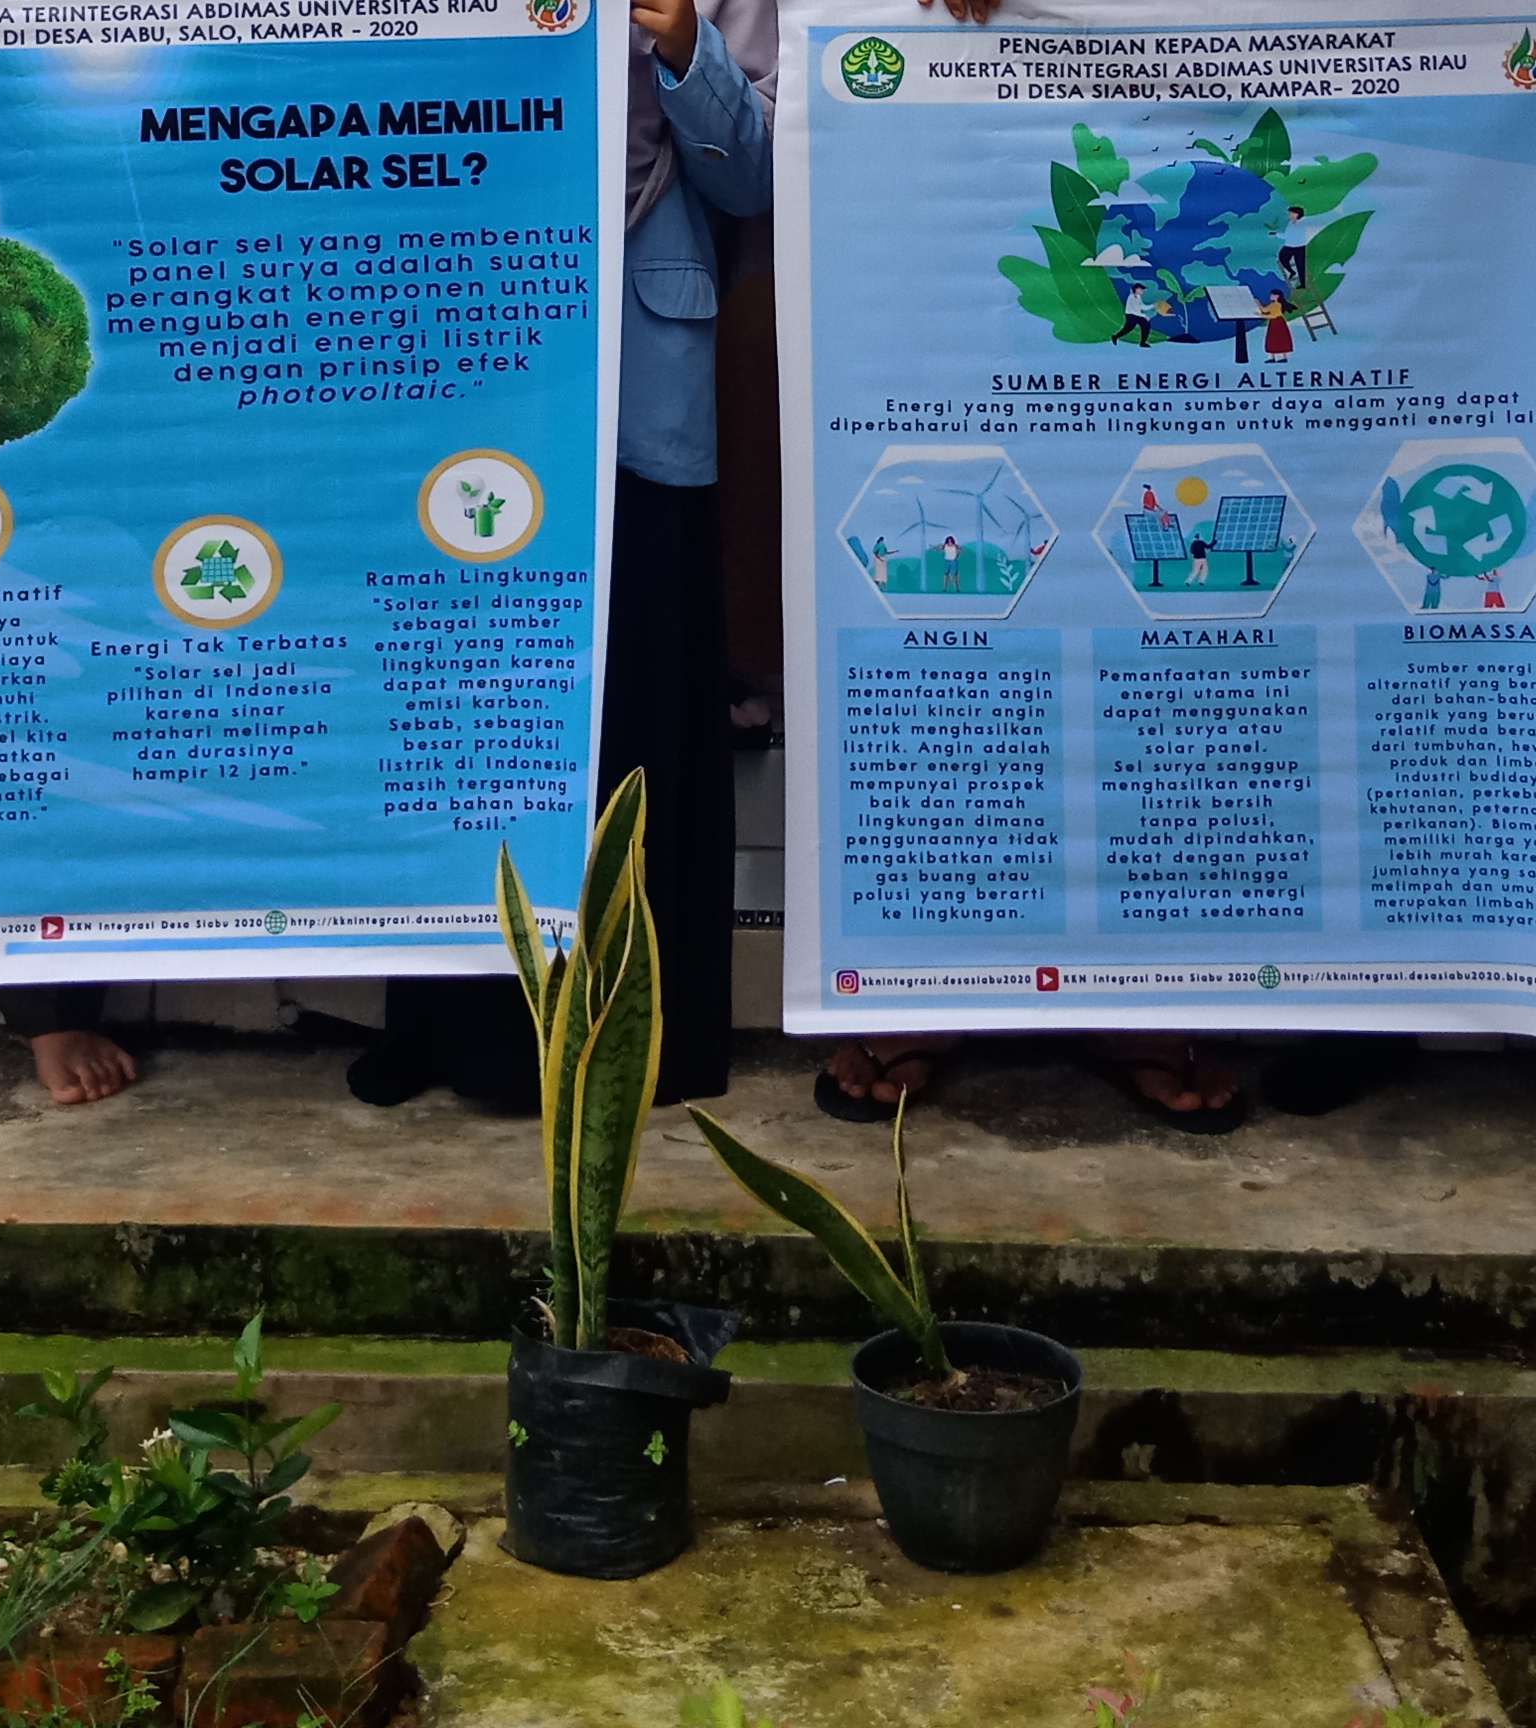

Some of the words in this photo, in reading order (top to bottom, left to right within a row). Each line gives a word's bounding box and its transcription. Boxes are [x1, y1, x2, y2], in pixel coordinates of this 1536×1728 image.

[22, 4, 177, 23] TERINTEGRASI
[186, 1, 291, 20] ABDIMAS
[3, 29, 25, 45] DI
[35, 28, 93, 45] DESA
[101, 26, 171, 45] SIABU,
[179, 24, 242, 43] SALO,
[251, 22, 343, 40] KAMPAR
[369, 20, 418, 37] 2020
[1000, 37, 1145, 55] PENGABDIAN
[1155, 37, 1242, 54] KEPADA
[1248, 32, 1395, 52] MASYARAKAT
[929, 60, 1018, 78] KUKERTA
[1022, 62, 1167, 78] TERINTEGRASI
[1175, 60, 1273, 78] ABDIMAS
[1279, 56, 1412, 75] UNIVERSITAS
[1420, 54, 1466, 71] RIAU
[998, 83, 1018, 99] DI
[1028, 83, 1084, 99] DESA
[1092, 83, 1161, 102] SIABU,
[1168, 83, 1232, 102] SALO,
[1351, 78, 1400, 95] 2020
[378, 97, 563, 136] MEMILIH
[220, 156, 372, 193] SOLAR
[382, 152, 487, 189] SEL?
[236, 234, 282, 254] sel
[299, 234, 381, 256] yang
[400, 225, 592, 251] membentuk
[130, 261, 225, 286] panel
[242, 261, 338, 282] surya
[355, 253, 472, 275] adalah
[490, 251, 578, 271] suatu
[107, 284, 290, 312] perangkat
[307, 281, 484, 304] komponen
[501, 276, 589, 296] untuk
[108, 309, 289, 336] mengubah
[306, 304, 417, 329] energi
[436, 301, 588, 323] matahari
[160, 333, 296, 359] menjadi
[315, 329, 426, 354] energi
[444, 326, 542, 348] listrik
[174, 363, 303, 385] dengan
[320, 355, 440, 382] prinsip
[457, 352, 529, 373] efek
[992, 374, 1101, 391] SUMBER
[1118, 373, 1219, 390] ENERGI
[1237, 368, 1409, 388] ALTERNATIF
[886, 399, 951, 417] Energi
[964, 403, 1014, 417] yang
[1026, 398, 1172, 416] menggunakan
[1185, 397, 1260, 411] sumber
[1271, 396, 1322, 414] daya
[1335, 395, 1385, 409] alam
[1396, 396, 1445, 411] yang
[1457, 391, 1519, 408] dapat
[830, 417, 968, 435] diperbaharui
[980, 418, 1018, 432] dan
[1030, 418, 1095, 432] ramah
[1108, 417, 1225, 435] lingkungan
[1237, 416, 1293, 430] untuk
[1305, 413, 1415, 431] mengganti
[1428, 410, 1494, 427] energi
[367, 569, 445, 586] Ramah
[461, 567, 587, 587] Lingkungan
[903, 631, 987, 646] ANGIN
[1141, 629, 1273, 645] MATAHARI
[1404, 624, 1535, 640] BIOMASSA
[91, 639, 168, 659] Energi
[183, 636, 224, 653] Tak
[237, 634, 347, 652] Terbatas
[848, 667, 910, 680] Sistem
[921, 668, 987, 684] tenaga
[998, 669, 1051, 684] angin
[1100, 668, 1230, 682] Pemanfaatan
[1241, 666, 1310, 680] sumber
[69, 922, 91, 931] KKN
[99, 921, 154, 933] Integrasi
[161, 920, 189, 929] Desa
[196, 919, 228, 929] Siabu
[235, 918, 262, 928] 2020
[1063, 974, 1086, 983] KKN
[1093, 974, 1149, 985] Integrasi
[1155, 973, 1183, 982] Desa
[1190, 973, 1222, 982] Siabu
[1228, 973, 1256, 982] 2020
